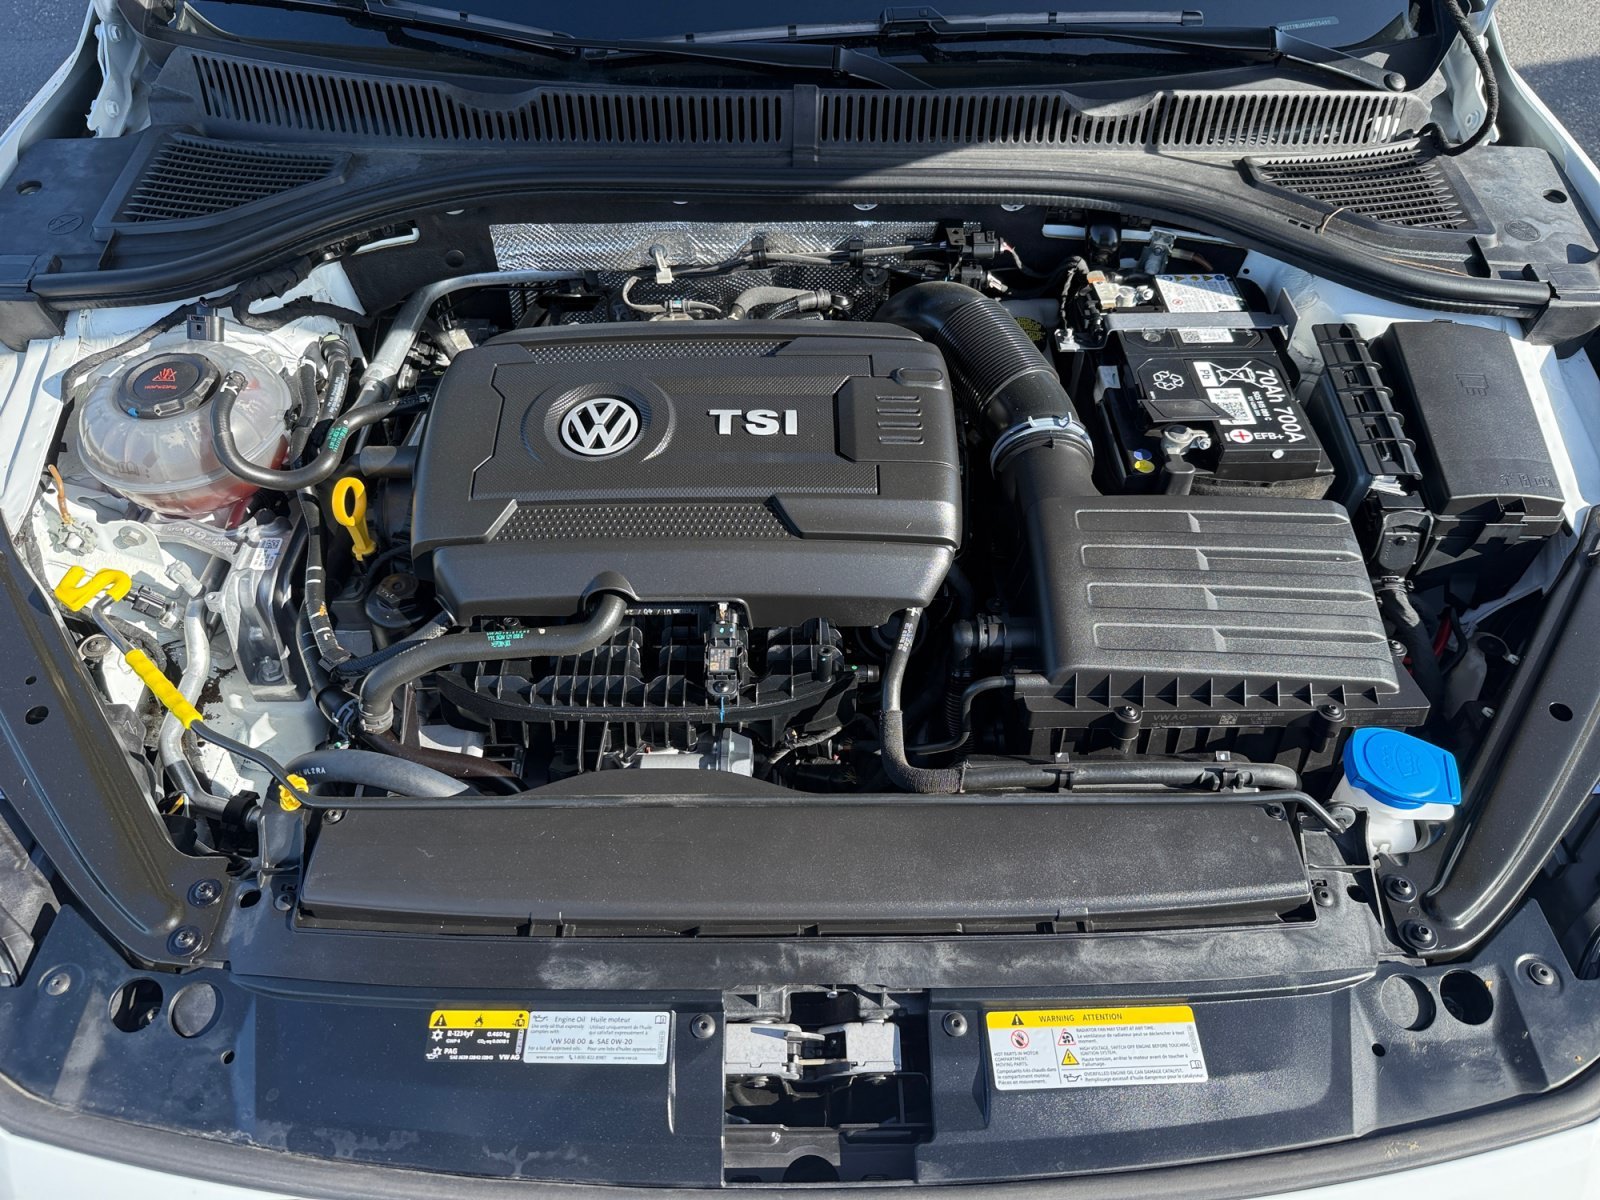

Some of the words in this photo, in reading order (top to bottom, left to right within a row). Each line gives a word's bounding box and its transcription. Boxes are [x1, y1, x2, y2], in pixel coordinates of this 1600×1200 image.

[1200, 368, 1211, 381] Pb
[1255, 368, 1286, 403] 70Ah
[1273, 406, 1306, 443] 700A
[561, 397, 639, 456] VW
[708, 408, 798, 436] TSI
[1253, 432, 1284, 440] EFB+
[1039, 1015, 1074, 1023] WARNING
[1082, 1013, 1122, 1021] ATTENTION
